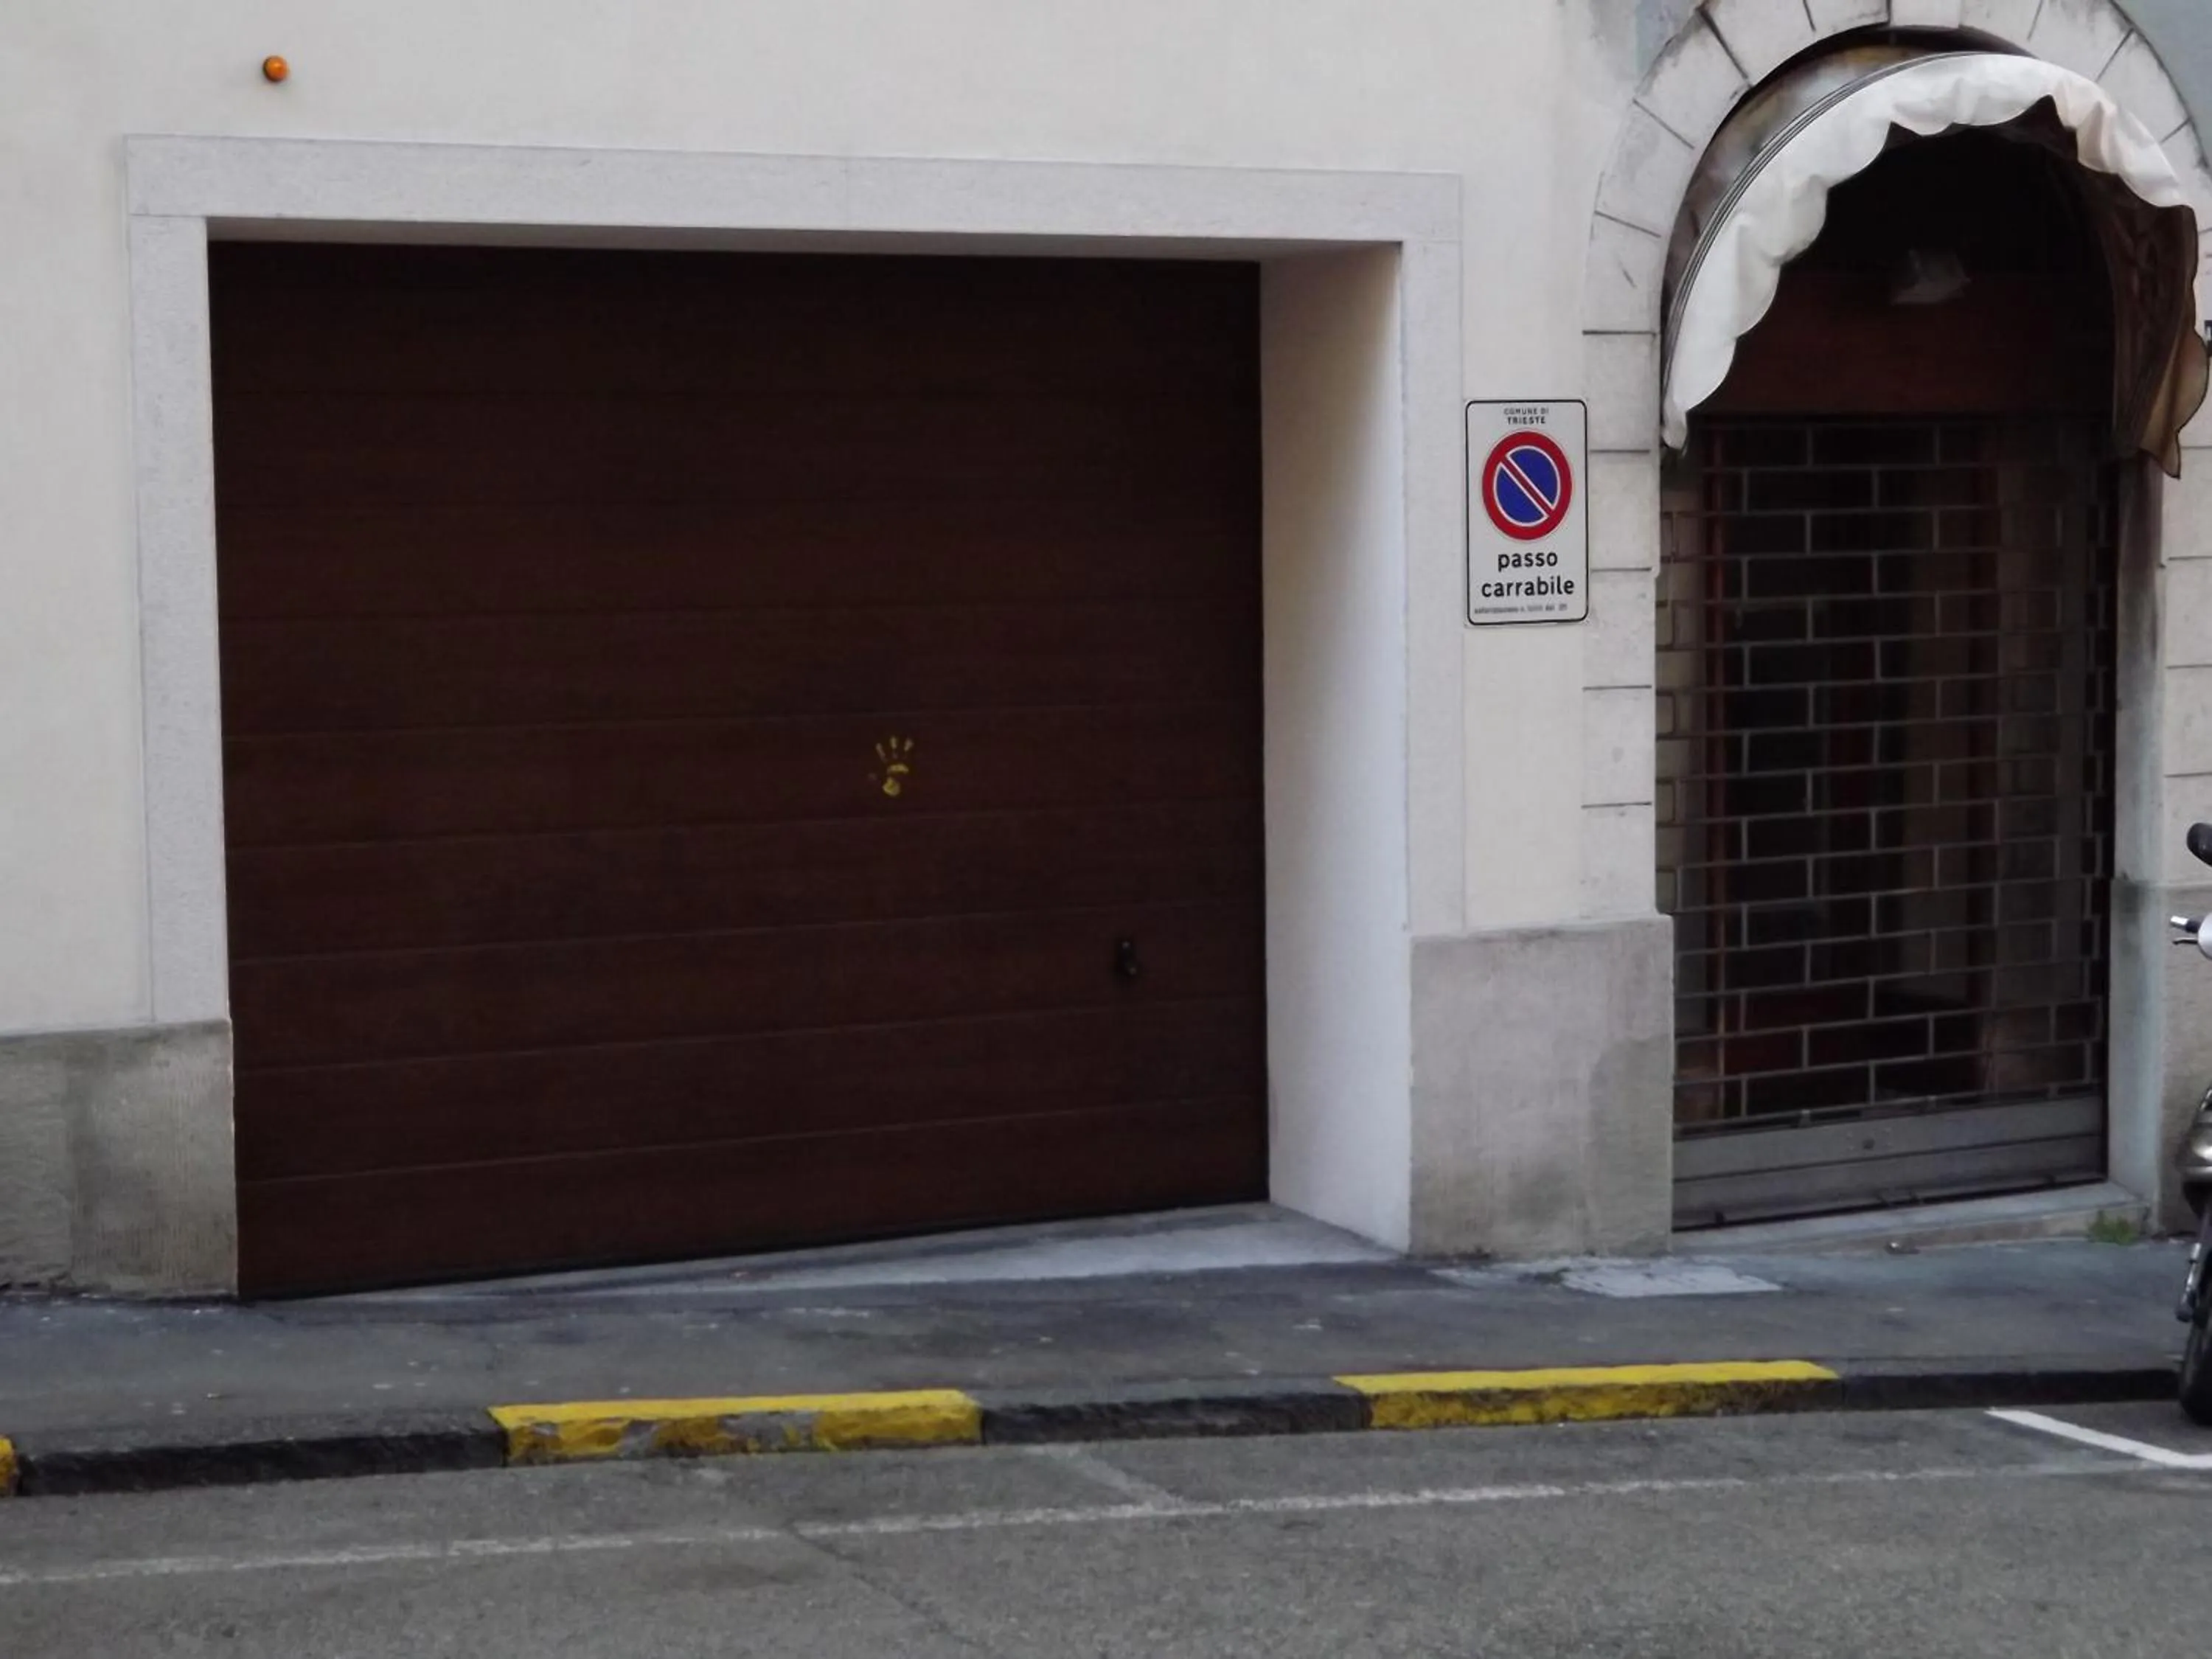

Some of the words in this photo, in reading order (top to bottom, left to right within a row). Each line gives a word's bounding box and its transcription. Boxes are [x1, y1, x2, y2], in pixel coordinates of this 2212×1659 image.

[1503, 407, 1538, 415] COMUNE
[1507, 416, 1546, 425] TRIESTE
[1498, 552, 1558, 572] passo
[1481, 575, 1574, 597] carrabile
